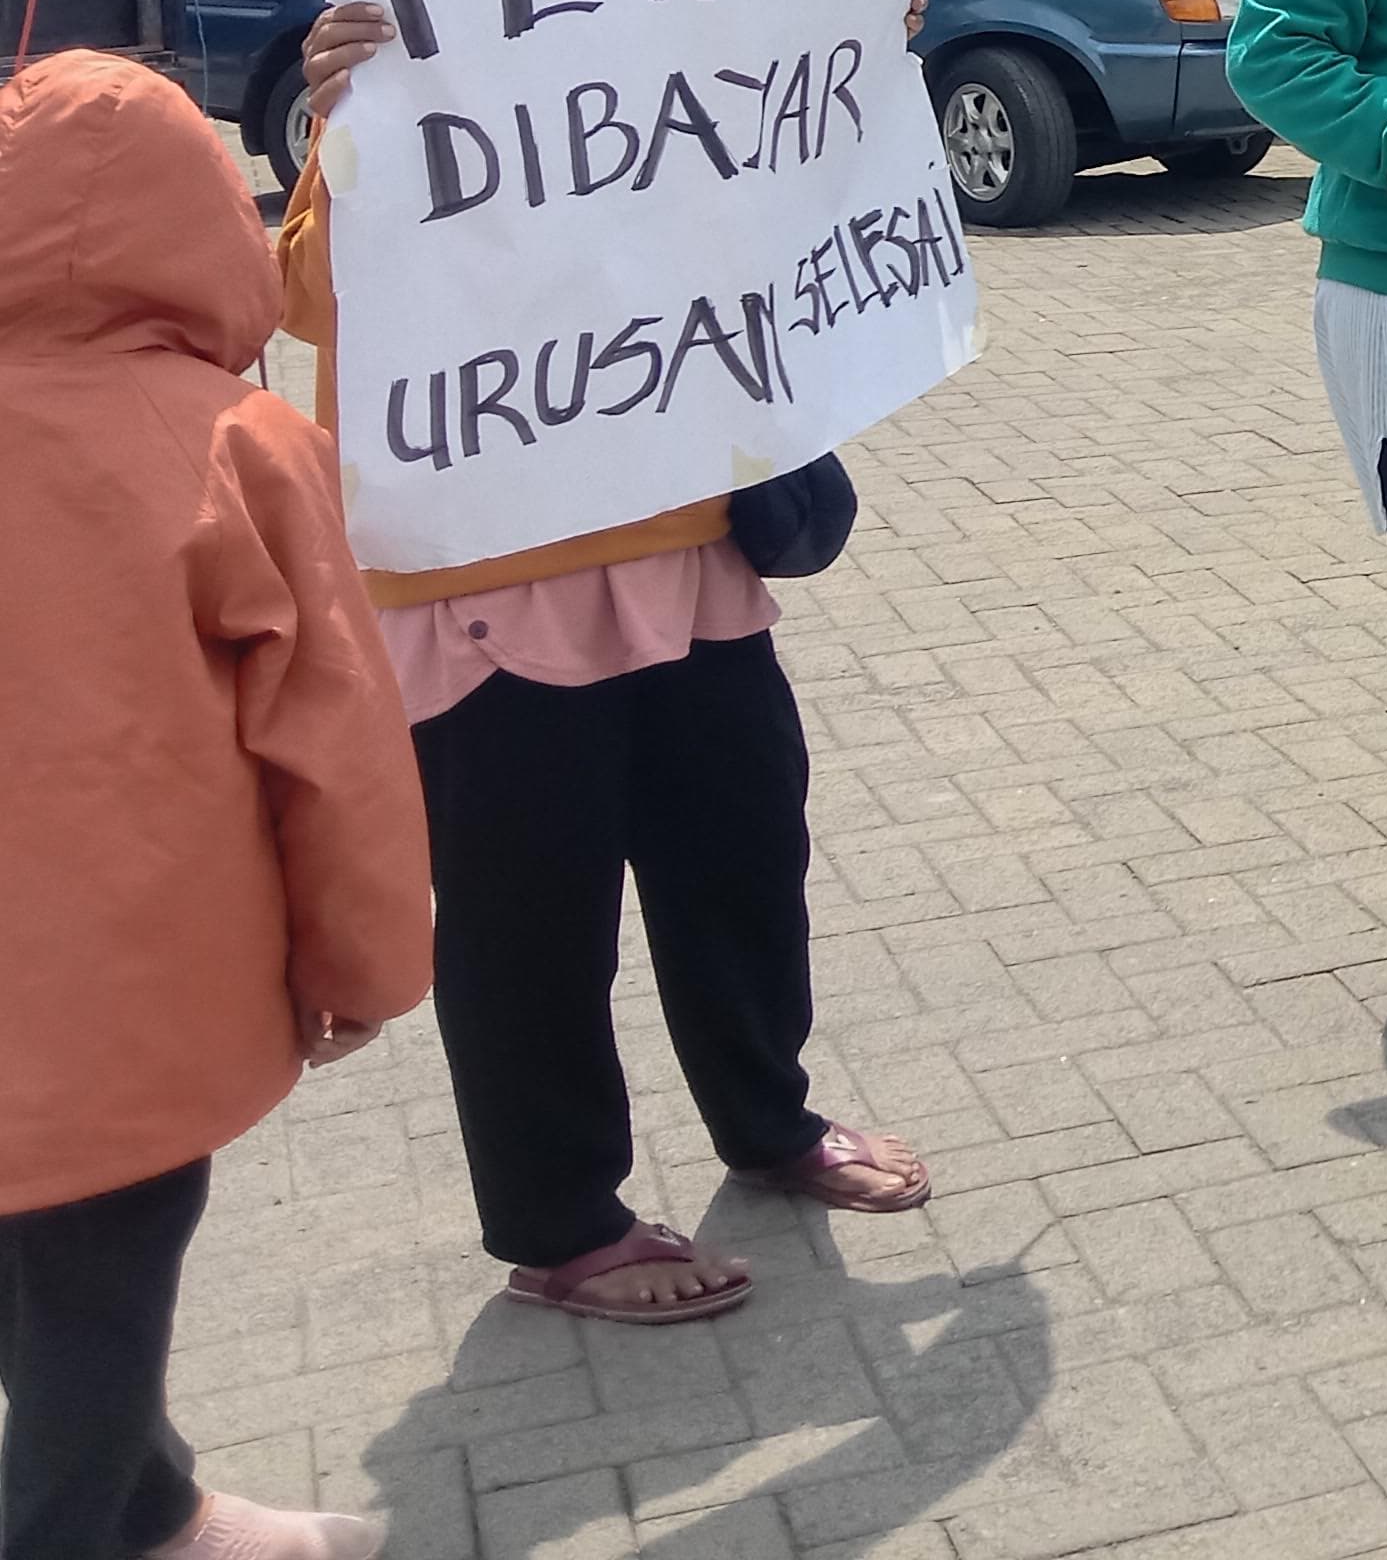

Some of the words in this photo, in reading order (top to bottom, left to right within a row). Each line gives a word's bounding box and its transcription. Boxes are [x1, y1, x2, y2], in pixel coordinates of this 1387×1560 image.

[418, 39, 864, 224] DIBAYAR
[387, 280, 795, 471] URUSAN
[789, 187, 965, 336] SELESAI
